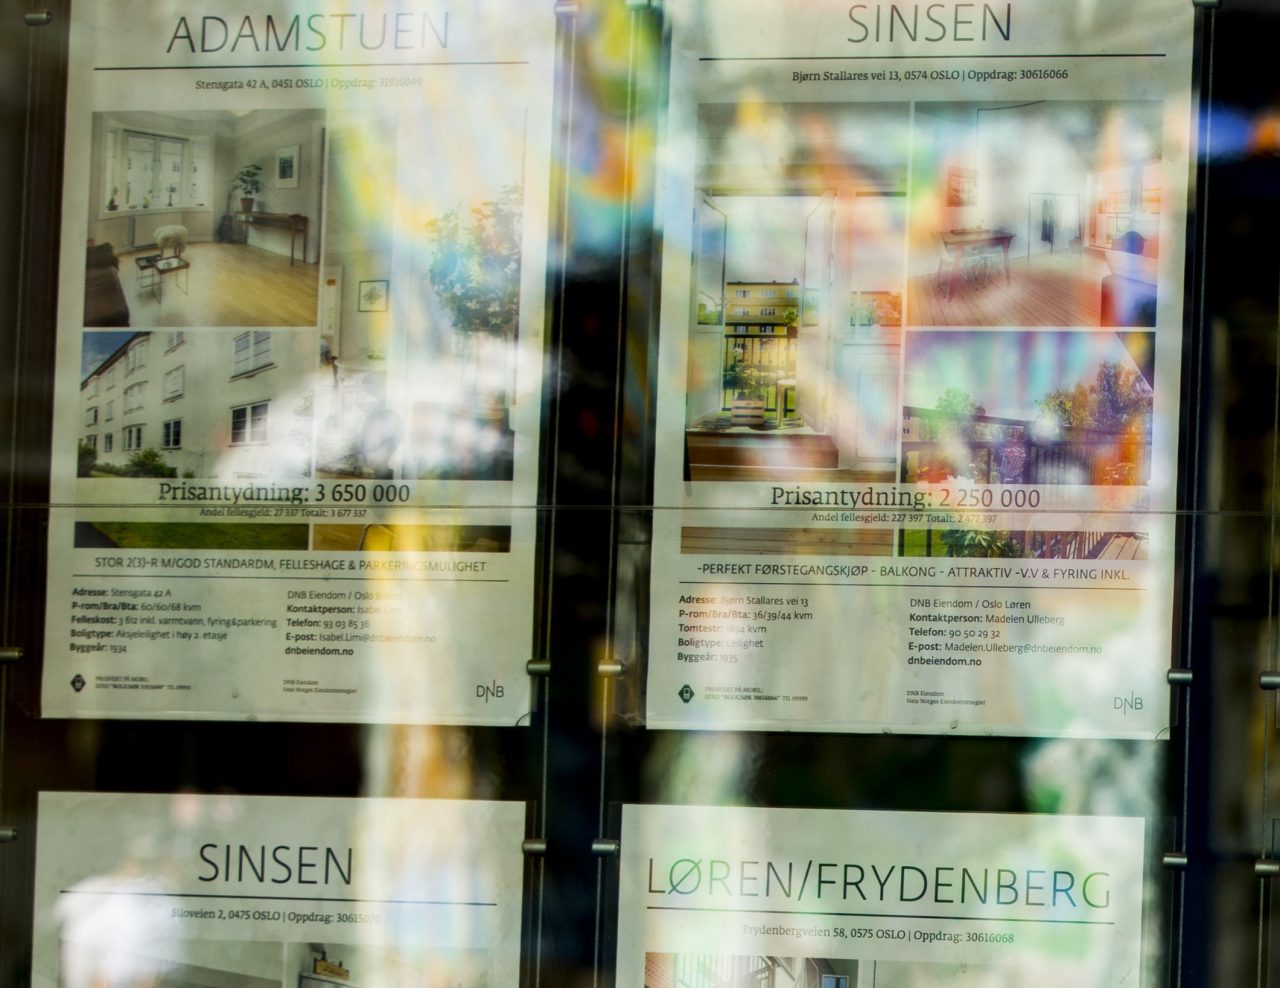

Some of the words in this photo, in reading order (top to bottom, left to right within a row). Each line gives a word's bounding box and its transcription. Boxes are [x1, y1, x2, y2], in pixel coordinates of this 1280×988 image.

[166, 10, 450, 53] ADAMSTUEN
[847, 3, 1011, 43] SINSEN
[791, 71, 820, 82] Bjørn
[822, 70, 868, 81] Stallares
[870, 70, 885, 80] vei
[888, 70, 901, 81] 13,
[904, 70, 928, 80] 0574
[929, 69, 960, 80] OSLO
[967, 69, 1017, 81] Oppdrag:
[1020, 68, 1068, 79] 30616066
[158, 482, 310, 507] Prisantydning:
[314, 483, 325, 501] 3
[331, 483, 366, 502] 650
[372, 484, 410, 503] 000
[769, 485, 933, 511] Prisantydning:
[938, 488, 951, 508] 2
[956, 489, 994, 509] 250
[999, 489, 1041, 509] 000
[907, 655, 982, 666] dnbeiendom.no
[475, 679, 504, 703] DNB
[1113, 690, 1143, 715] DNB
[197, 843, 352, 885] SINSEN
[648, 857, 1109, 908] LØREN/FRYDENBERG
